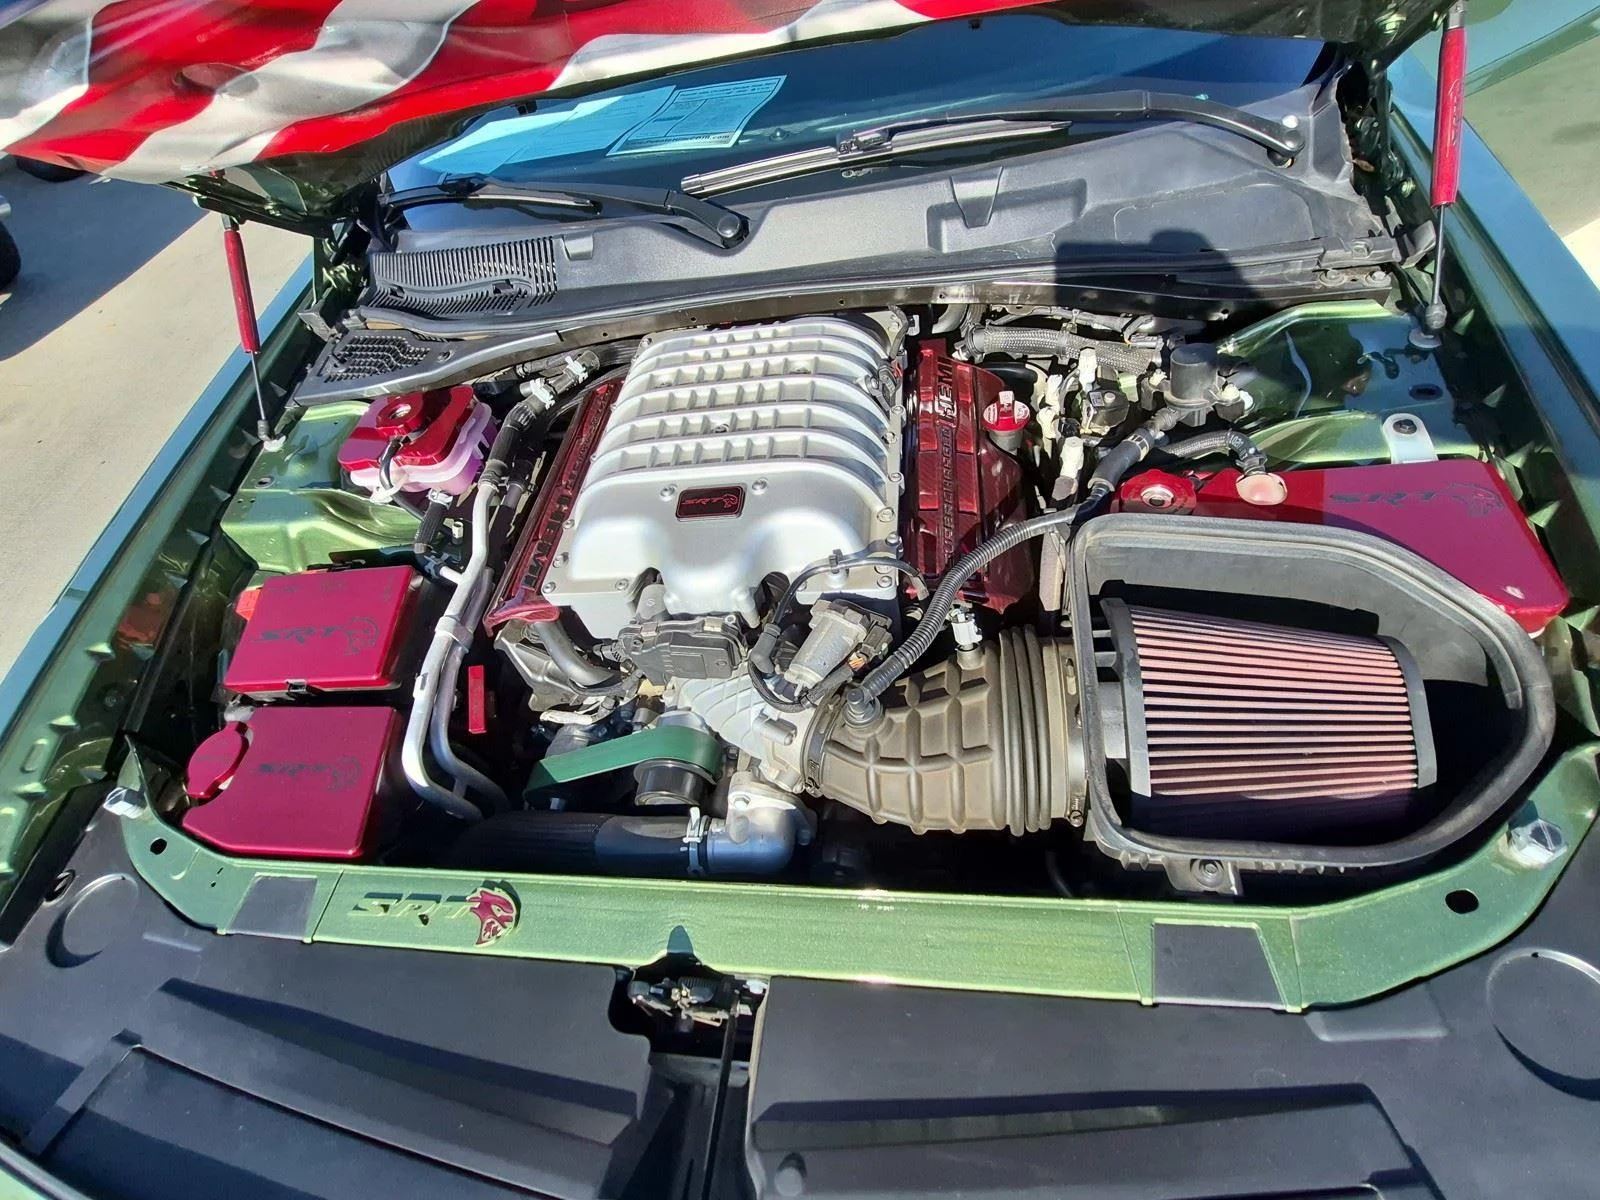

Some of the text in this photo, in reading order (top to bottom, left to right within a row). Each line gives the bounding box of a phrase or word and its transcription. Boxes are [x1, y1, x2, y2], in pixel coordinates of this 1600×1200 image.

[934, 360, 956, 419] HEMI
[1329, 491, 1447, 508] SRT
[523, 494, 571, 589] HEMI
[253, 624, 348, 643] SRT
[347, 892, 469, 925] SRT
